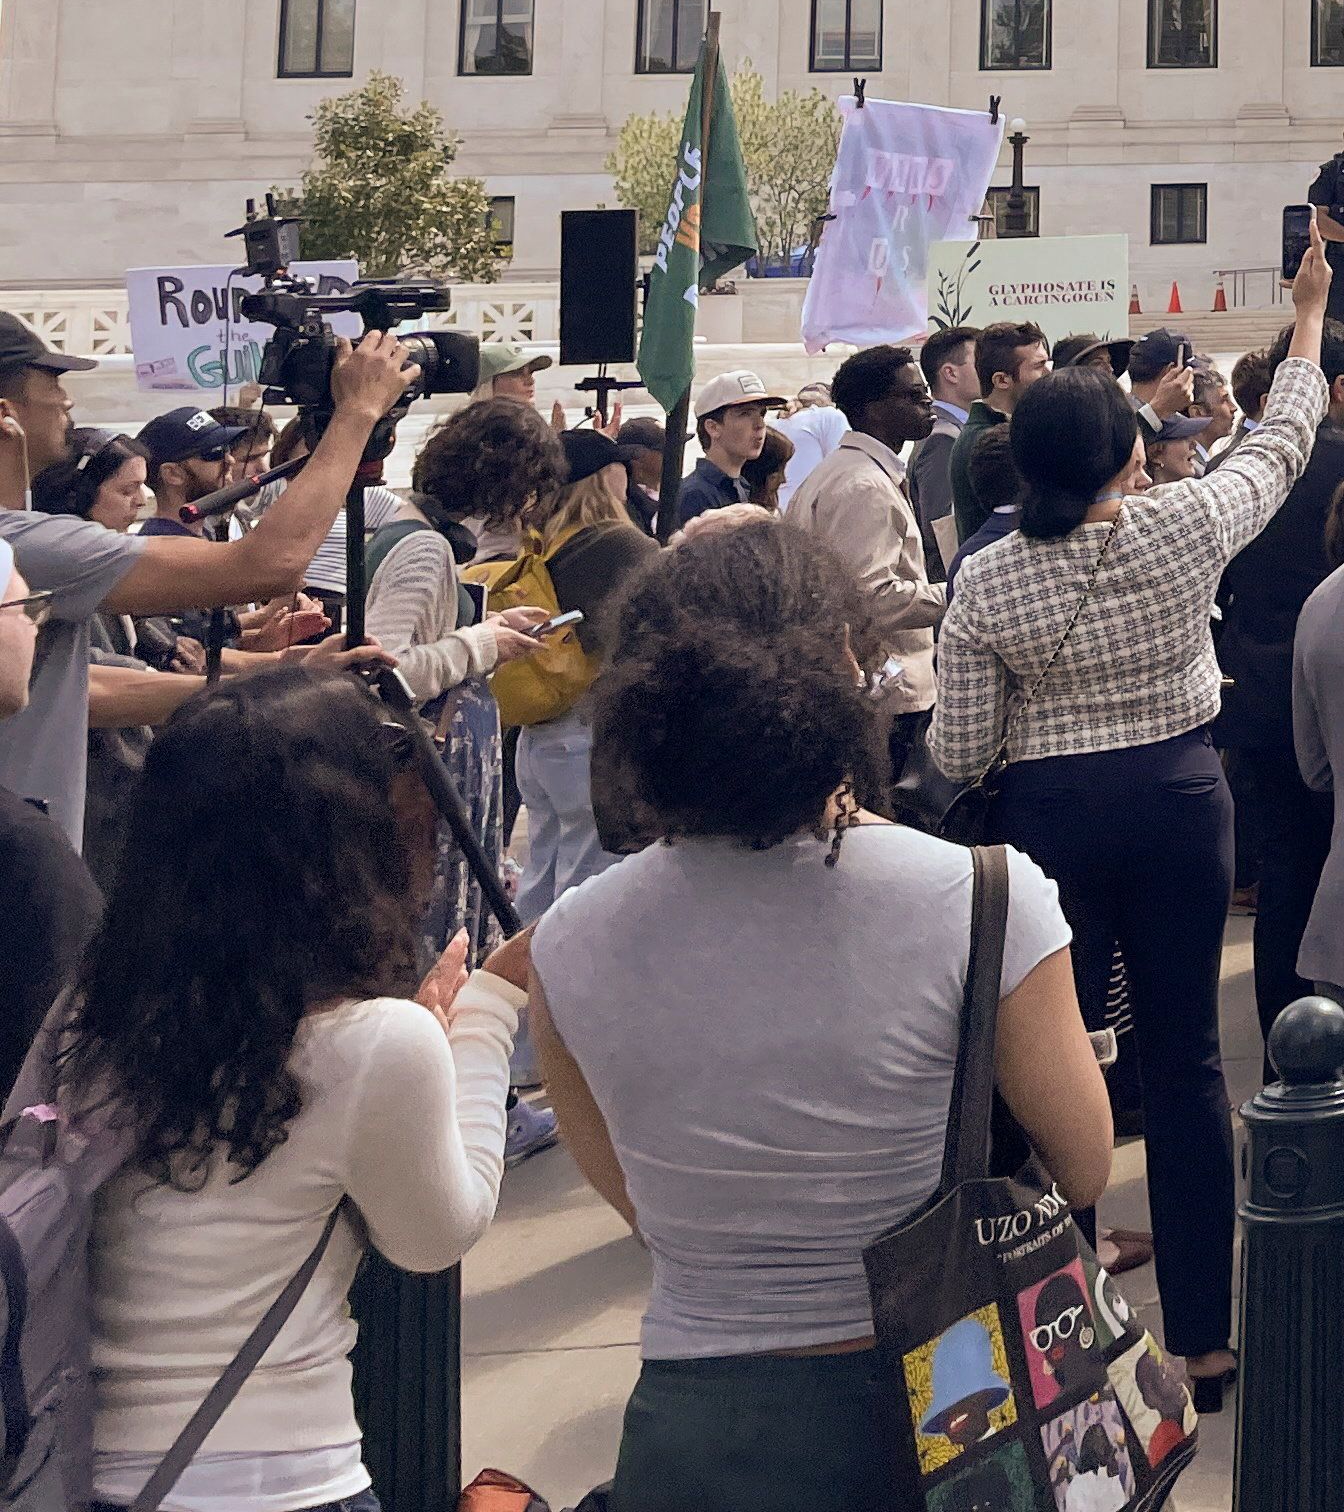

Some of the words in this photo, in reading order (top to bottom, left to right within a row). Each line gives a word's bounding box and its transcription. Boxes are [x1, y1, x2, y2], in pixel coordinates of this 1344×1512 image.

[988, 279, 1096, 295] GLYPHOSATE
[1101, 279, 1115, 290] IS
[988, 297, 999, 307] A
[1002, 291, 1115, 306] CARCINGOGEN
[974, 1210, 1032, 1246] UZO
